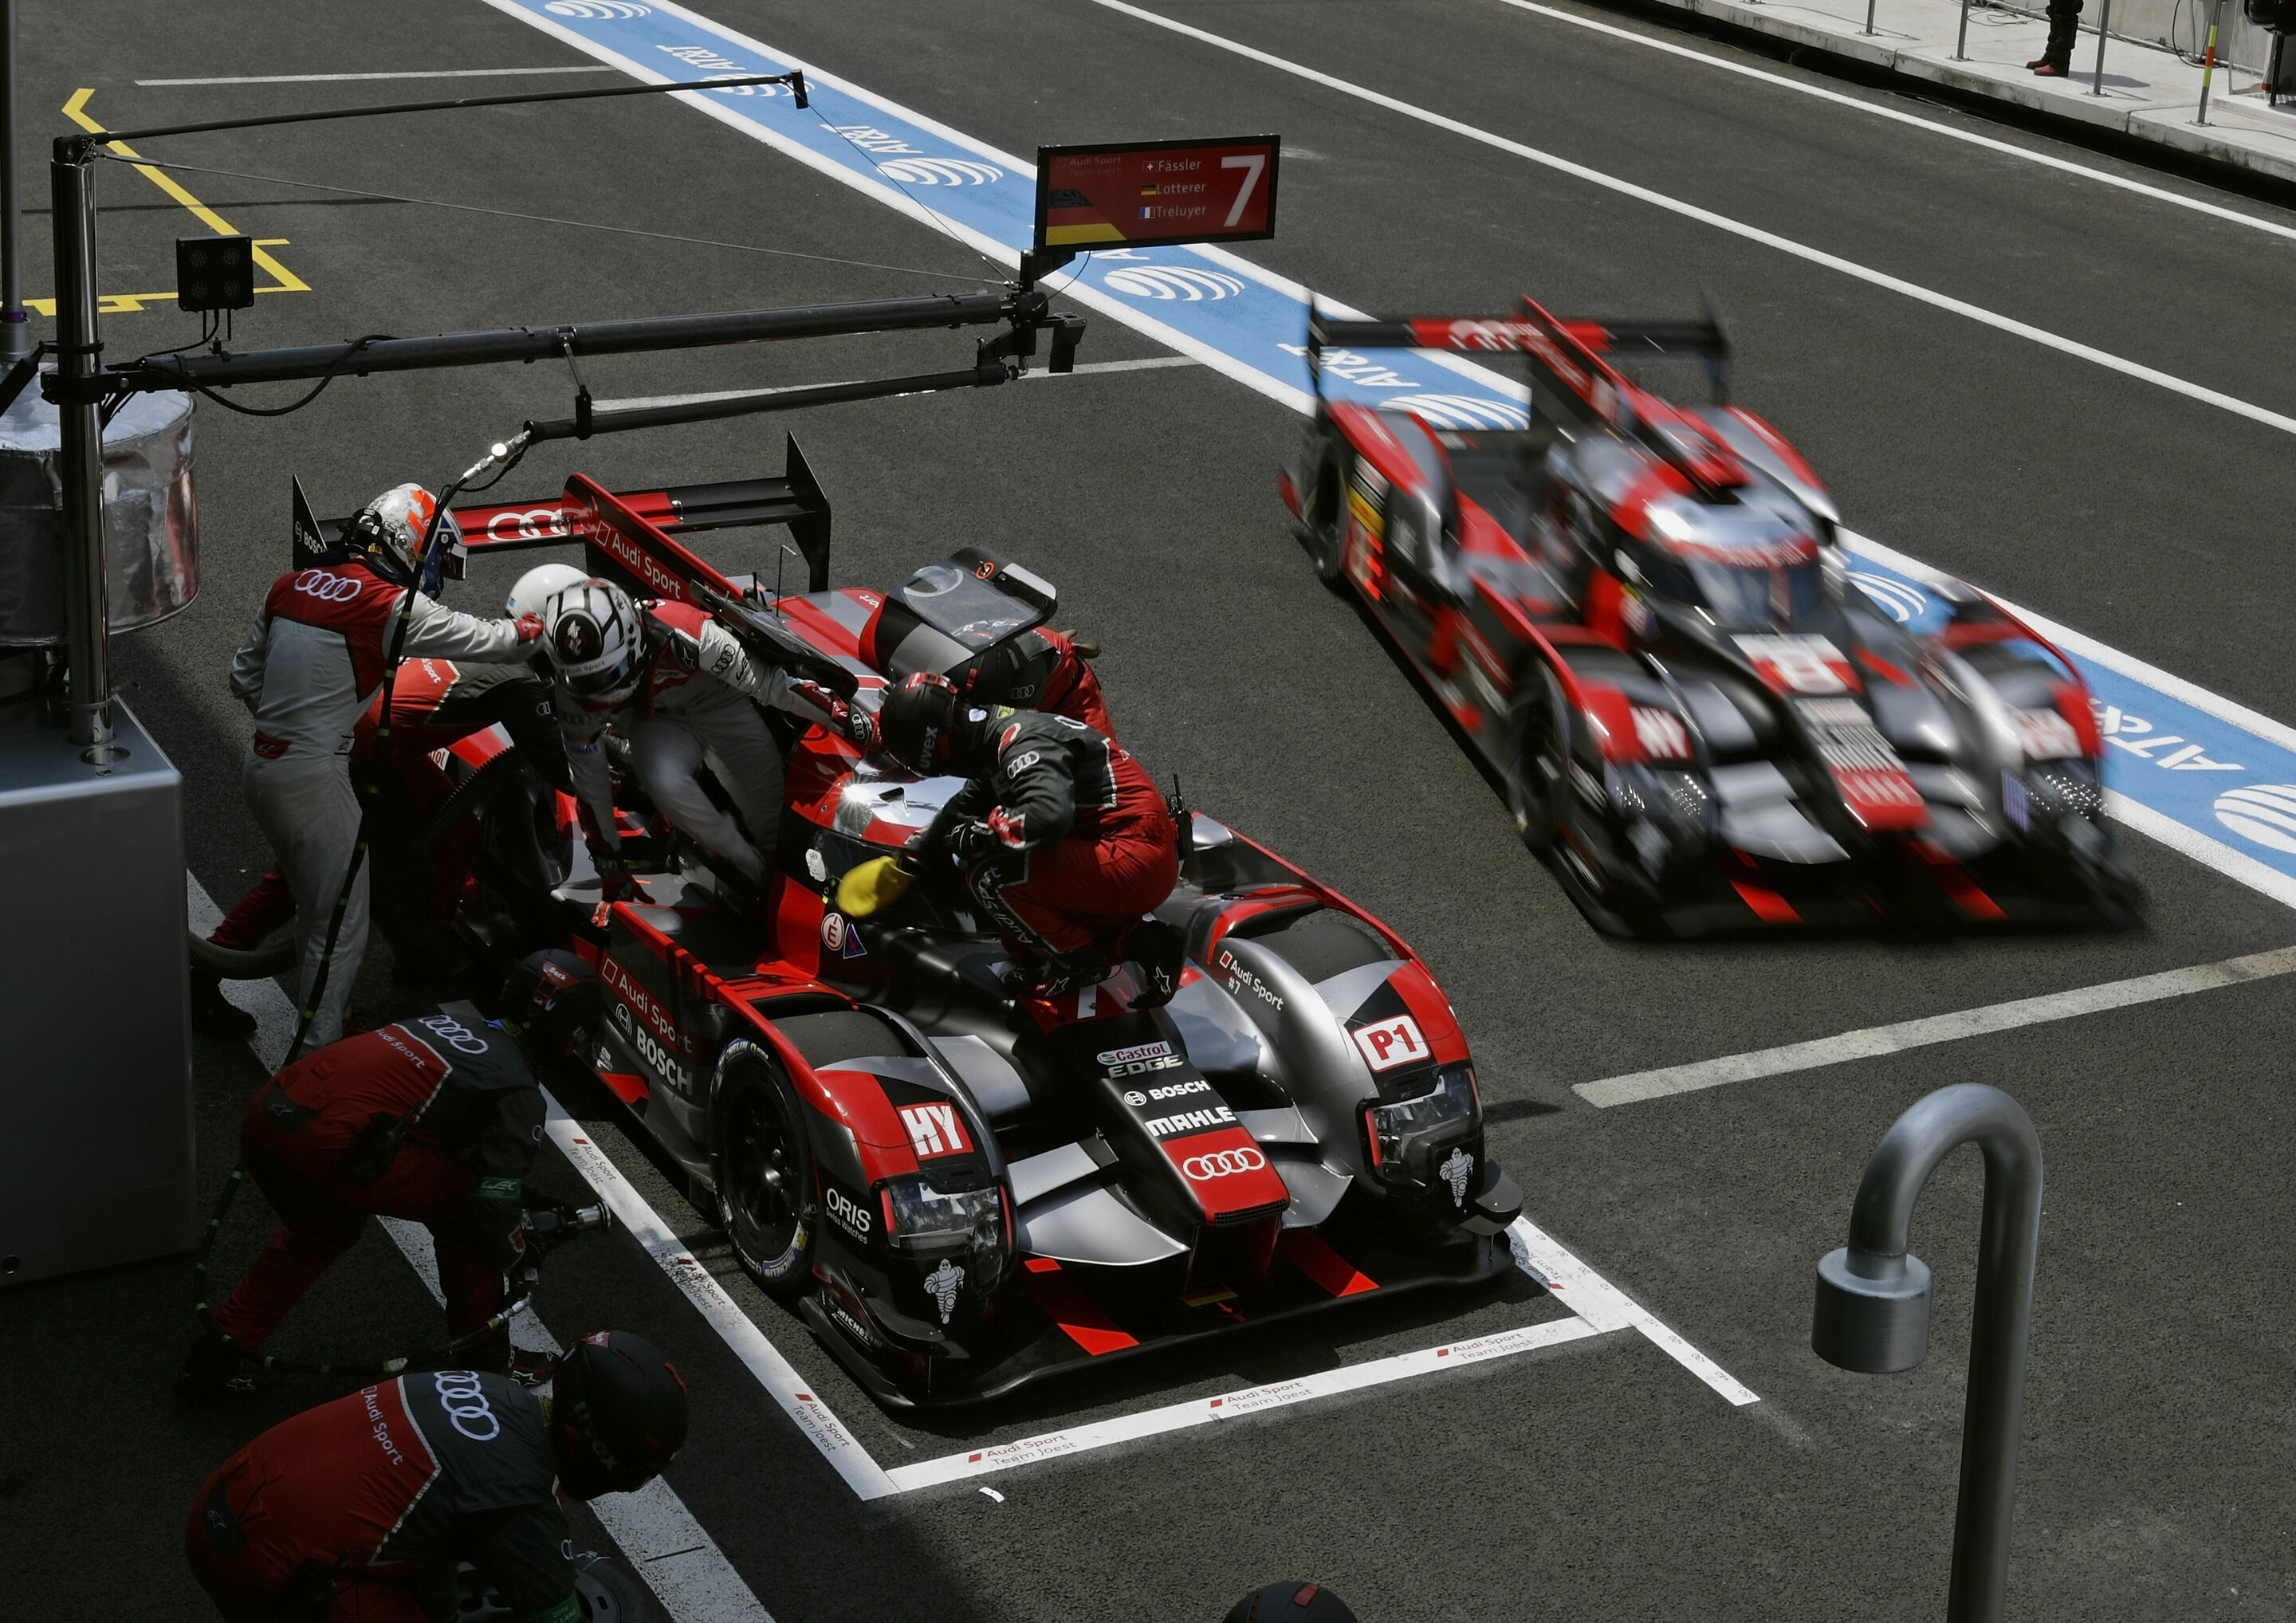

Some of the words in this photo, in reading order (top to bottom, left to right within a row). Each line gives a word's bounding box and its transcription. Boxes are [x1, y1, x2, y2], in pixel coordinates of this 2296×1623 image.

[655, 45, 746, 70] AT&T
[820, 124, 924, 154] AT&T
[1069, 157, 1092, 167] Audi
[1094, 156, 1122, 166] Sport
[1158, 159, 1201, 171] Fässler
[1156, 183, 1206, 195] Lotterer
[1221, 154, 1265, 227] 7
[1156, 204, 1207, 218] Tréluyer
[611, 532, 641, 568] Audi
[643, 556, 681, 599] Sport
[919, 725, 938, 770] uvex
[2089, 698, 2246, 771] AT&
[1229, 977, 1240, 995] #7
[1230, 959, 1253, 986] Audi
[1252, 977, 1284, 1011] Sport
[618, 973, 647, 1015] Audi
[651, 1004, 693, 1054] Sport
[391, 1040, 426, 1069] Sport
[1115, 1043, 1167, 1061] Castrol
[1366, 1024, 1417, 1061] P1
[637, 1024, 693, 1096] BOSCH
[1107, 1054, 1184, 1079] EDGE
[1148, 1080, 1211, 1100] BOSCH
[900, 1105, 963, 1156] HY
[1144, 1106, 1237, 1137] MAHLE
[569, 1147, 588, 1167] Team
[583, 1146, 597, 1161] Audi
[596, 1161, 616, 1181] Sport
[825, 1205, 841, 1225] Swiss
[841, 1218, 868, 1244] Watches
[826, 1187, 871, 1232] ORIS
[703, 1281, 725, 1306] Sport
[836, 1307, 883, 1348] MICHELIN
[1453, 1341, 1483, 1353] Audi
[1484, 1333, 1524, 1345] Sport
[1460, 1348, 1497, 1360] Team
[1499, 1339, 1534, 1352] Joest
[1228, 1391, 1259, 1403] Audi
[1261, 1381, 1303, 1394] Sport
[1232, 1399, 1274, 1411] Team
[1276, 1389, 1314, 1402] Joest
[364, 1393, 383, 1423] Audi
[792, 1405, 816, 1429] Team
[811, 1429, 836, 1452] Joest
[806, 1403, 828, 1422] Audi
[824, 1422, 851, 1447] Sport
[372, 1422, 404, 1467] Sport
[987, 1444, 1021, 1457] Audi
[1024, 1435, 1067, 1448] Sport
[989, 1452, 1035, 1465] Team
[1036, 1441, 1078, 1456] Joest
